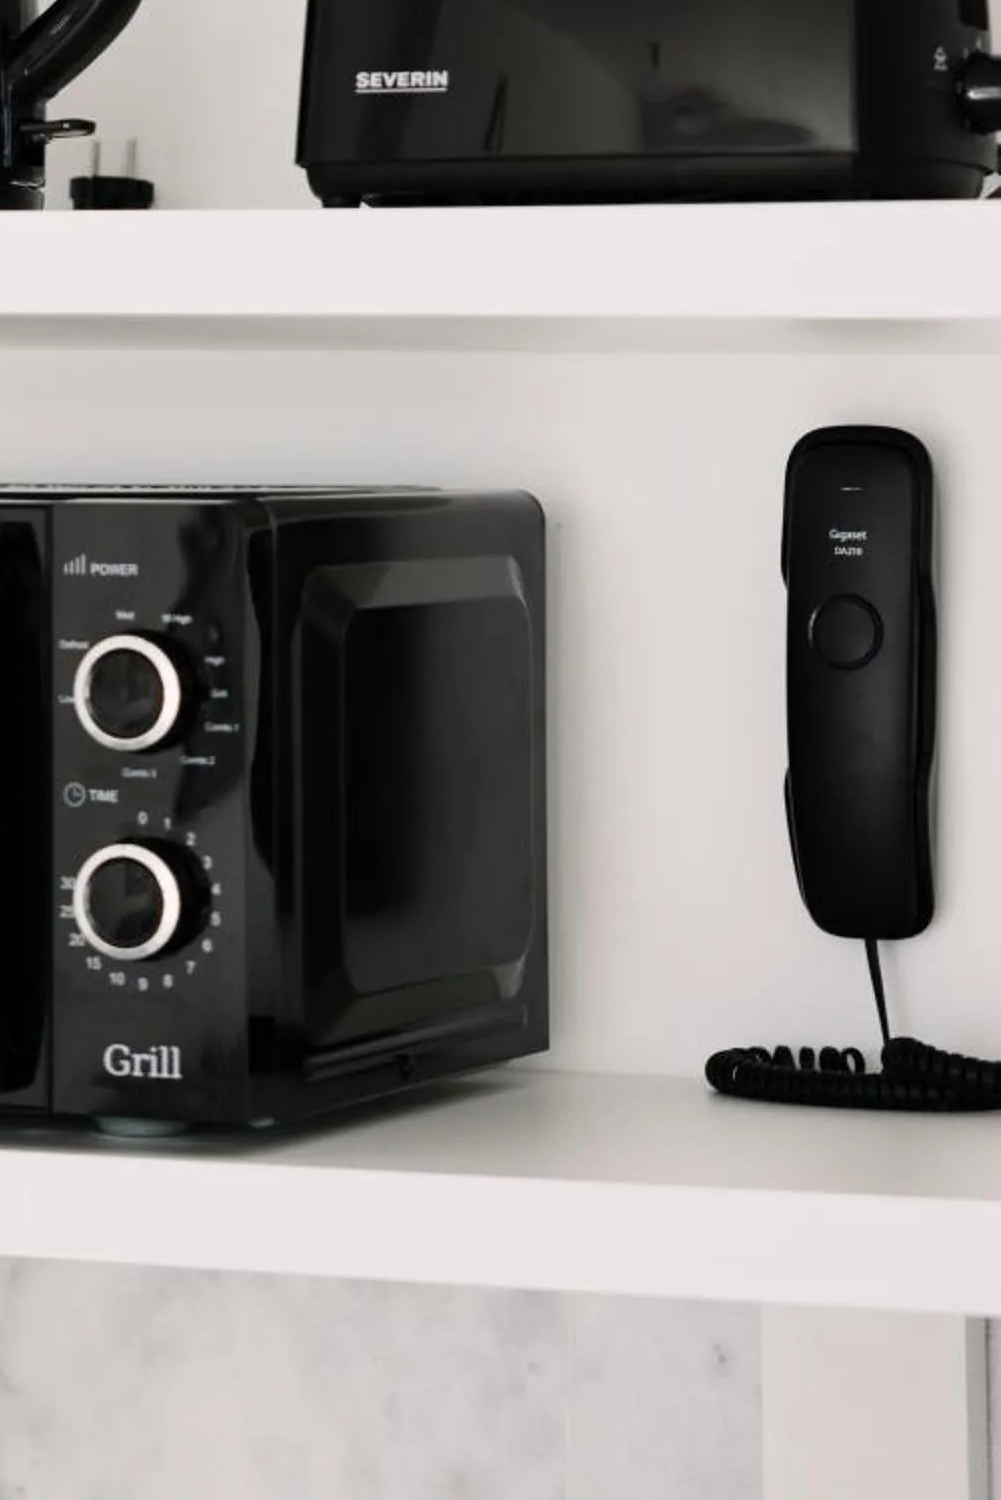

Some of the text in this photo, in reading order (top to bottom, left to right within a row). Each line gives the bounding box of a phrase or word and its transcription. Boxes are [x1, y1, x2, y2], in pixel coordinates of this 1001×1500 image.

[355, 70, 448, 88] SEVERIN
[89, 562, 139, 577] POWER
[89, 789, 119, 803] TIME
[137, 811, 148, 826] 0
[163, 816, 172, 830] 1
[186, 831, 197, 847] 2
[211, 882, 222, 896] 4
[210, 911, 222, 927] 5
[202, 938, 213, 953] 6
[86, 955, 102, 971] 15
[186, 960, 197, 975] 7
[108, 971, 126, 986] 10
[138, 977, 149, 992] 9
[102, 1043, 183, 1080] Grill
